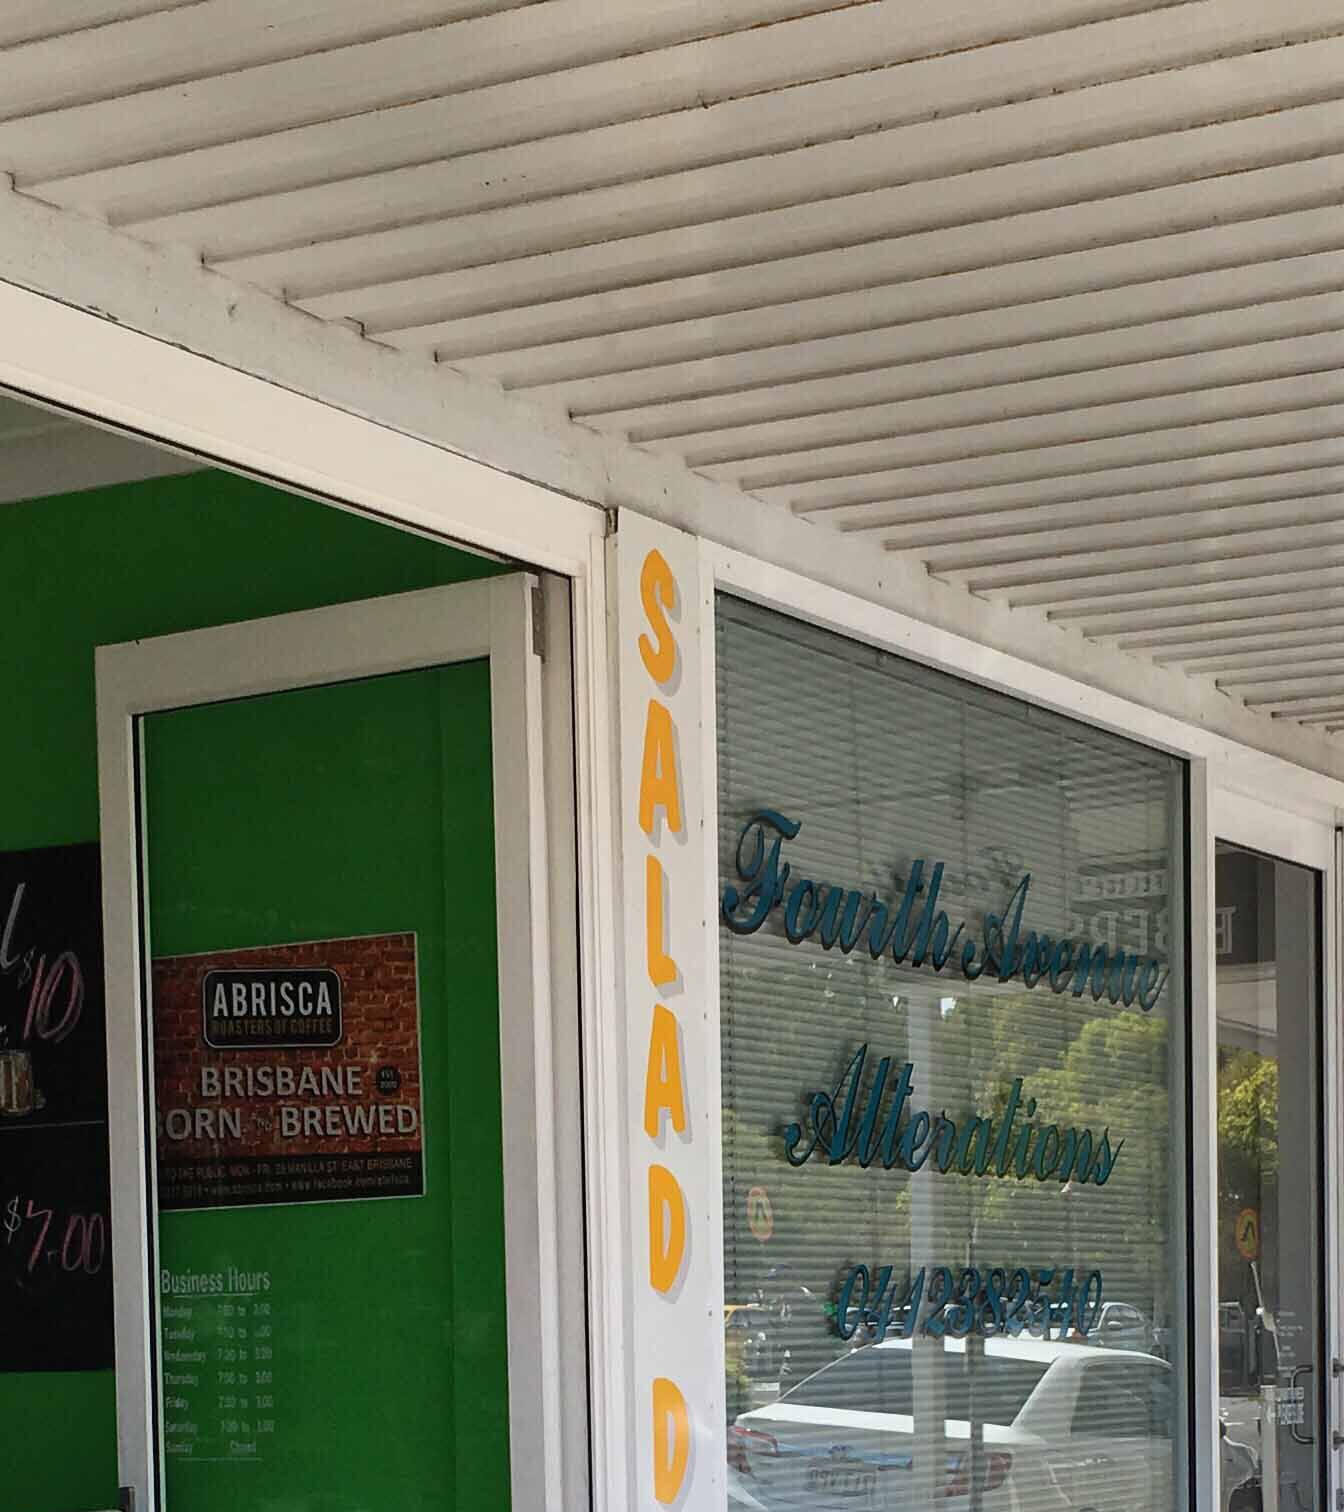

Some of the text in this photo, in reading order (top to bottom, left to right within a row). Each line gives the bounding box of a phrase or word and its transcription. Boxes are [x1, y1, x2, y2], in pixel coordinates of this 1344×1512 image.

[637, 549, 686, 1296] SALAD
[721, 808, 1169, 1013] Fourth Avenue
[212, 980, 334, 1019] ABRISCA
[200, 1065, 364, 1099] BRISBANE
[153, 1103, 419, 1141] ORN BREWED
[783, 1042, 1126, 1188] Alterations
[161, 1268, 271, 1294] Business Hours
